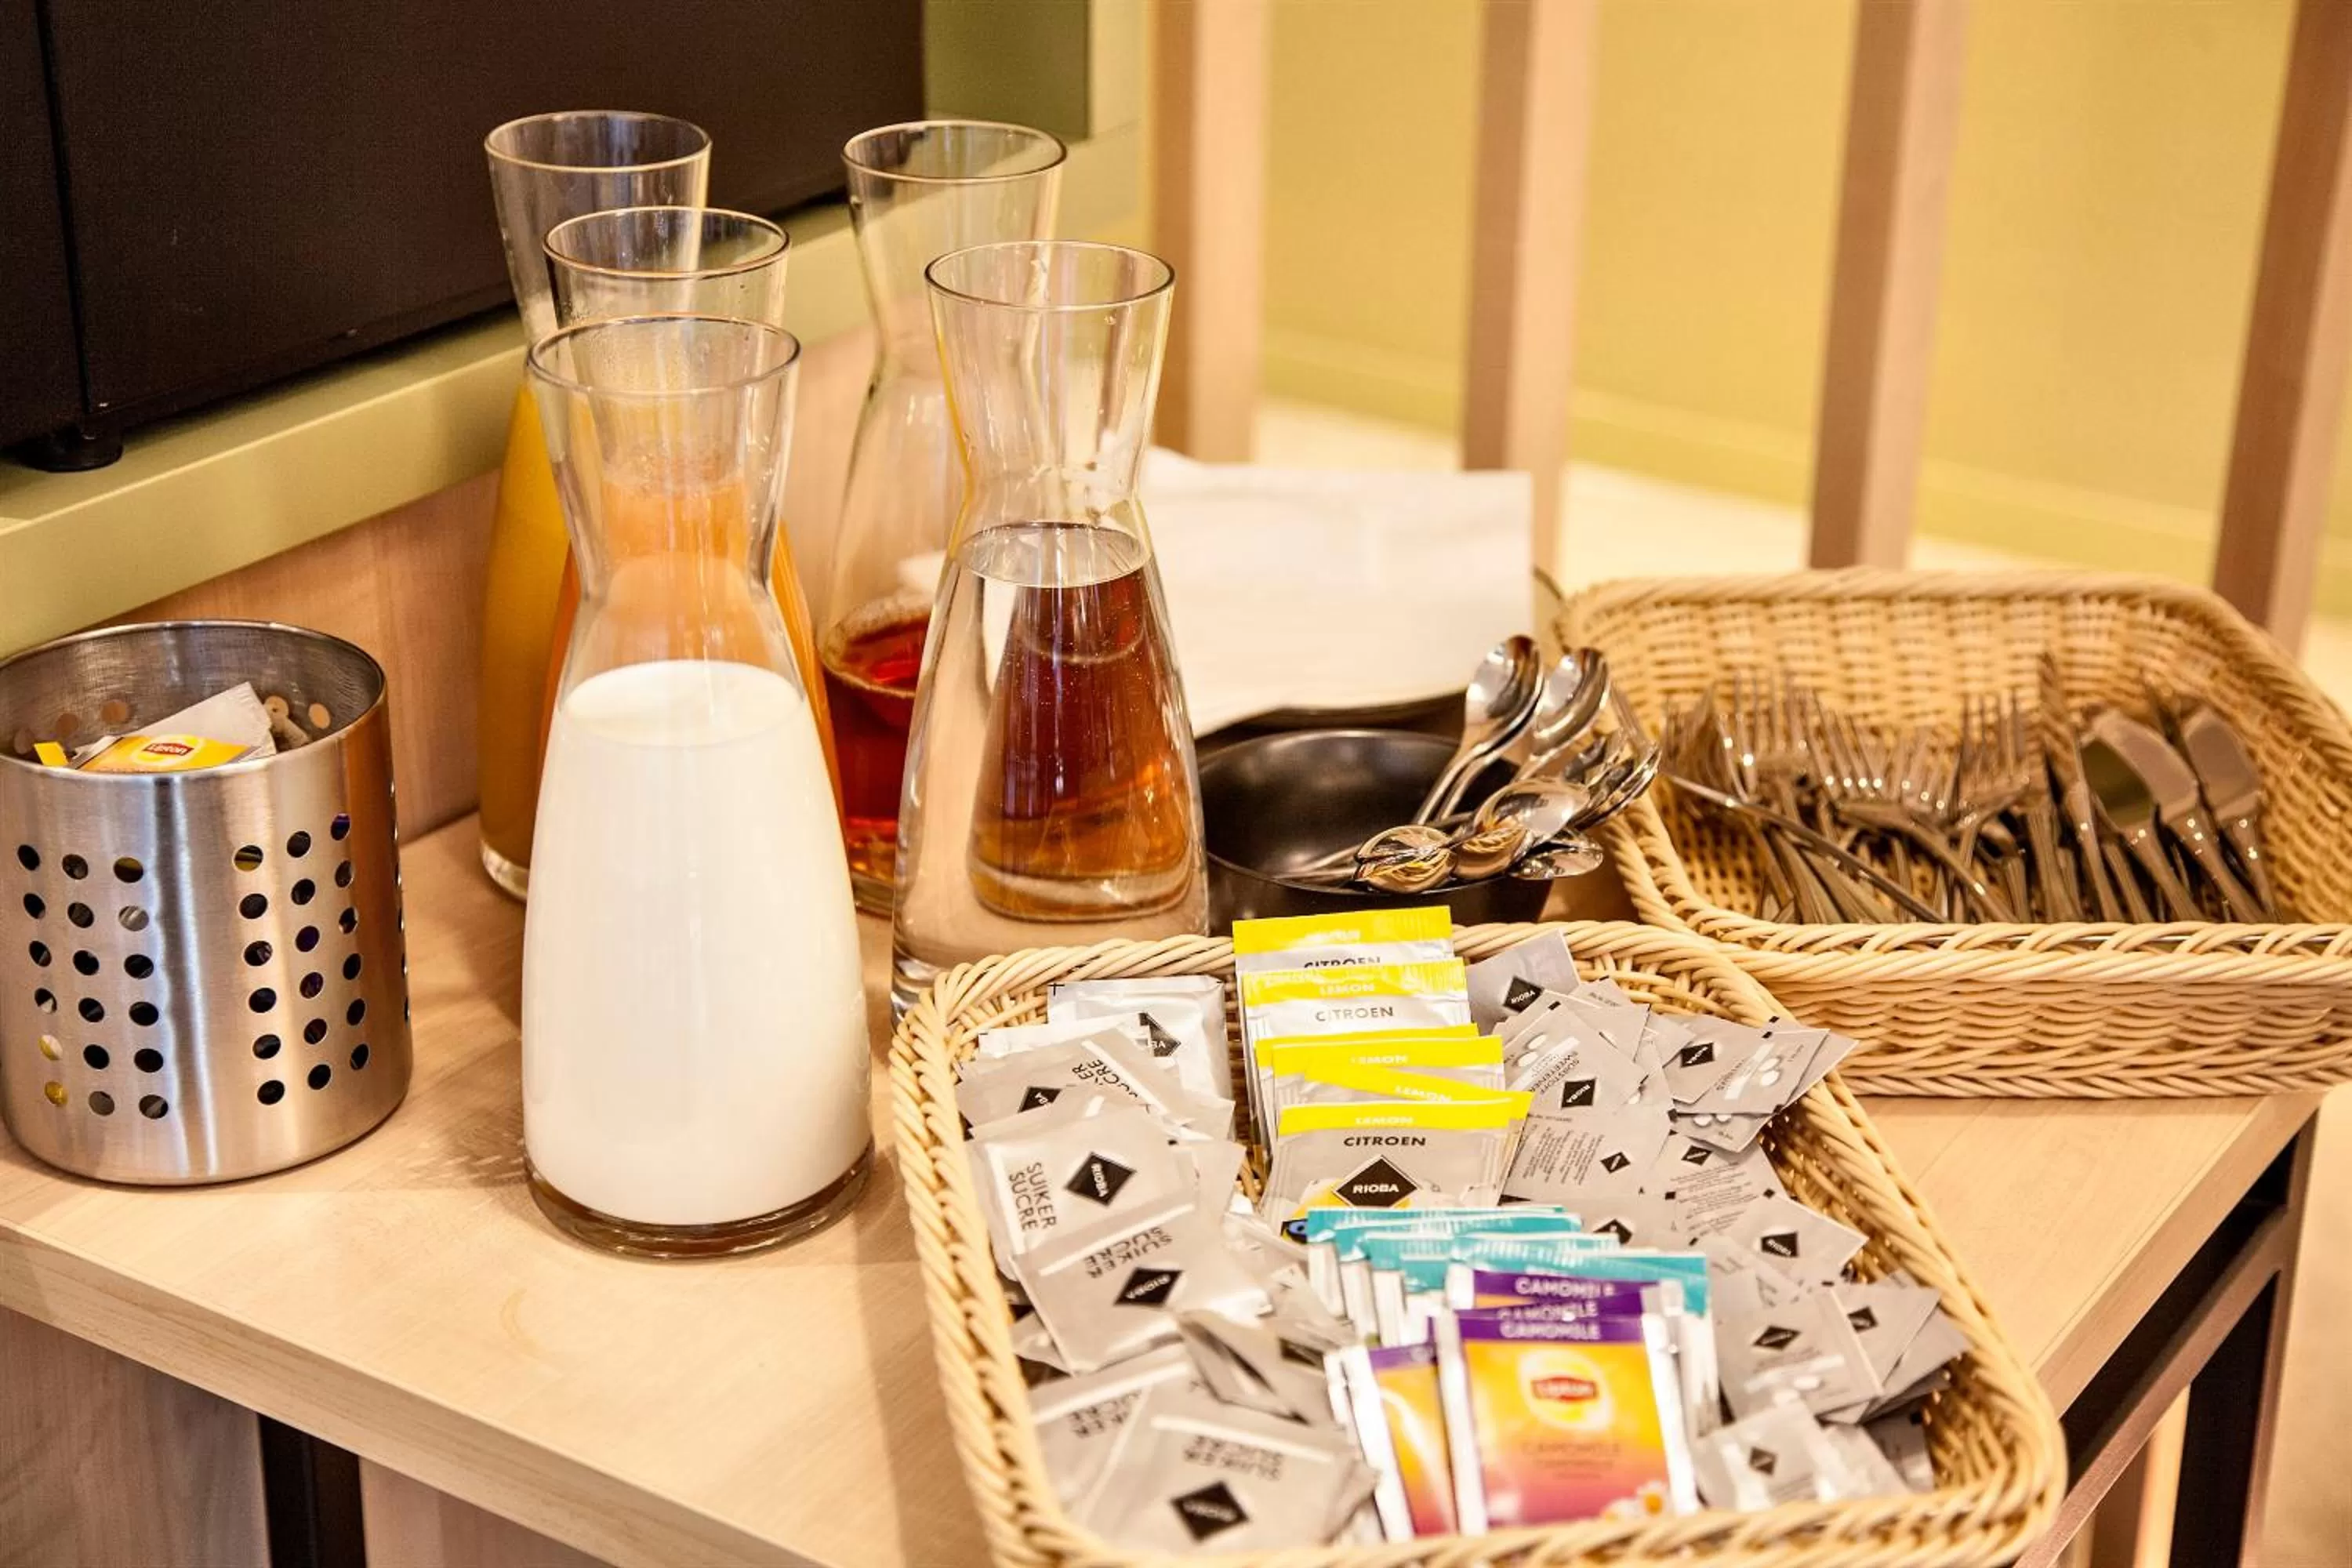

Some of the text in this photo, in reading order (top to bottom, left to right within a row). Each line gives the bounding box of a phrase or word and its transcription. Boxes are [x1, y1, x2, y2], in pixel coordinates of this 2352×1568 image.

[1315, 1006, 1394, 1022] CITROEN
[1343, 1136, 1426, 1147] CITROEN
[1091, 1163, 1109, 1197] RIOBA
[1352, 1183, 1399, 1194] RIOBA
[1009, 1172, 1038, 1232] SUCRE
[1026, 1162, 1057, 1230] SUIKER
